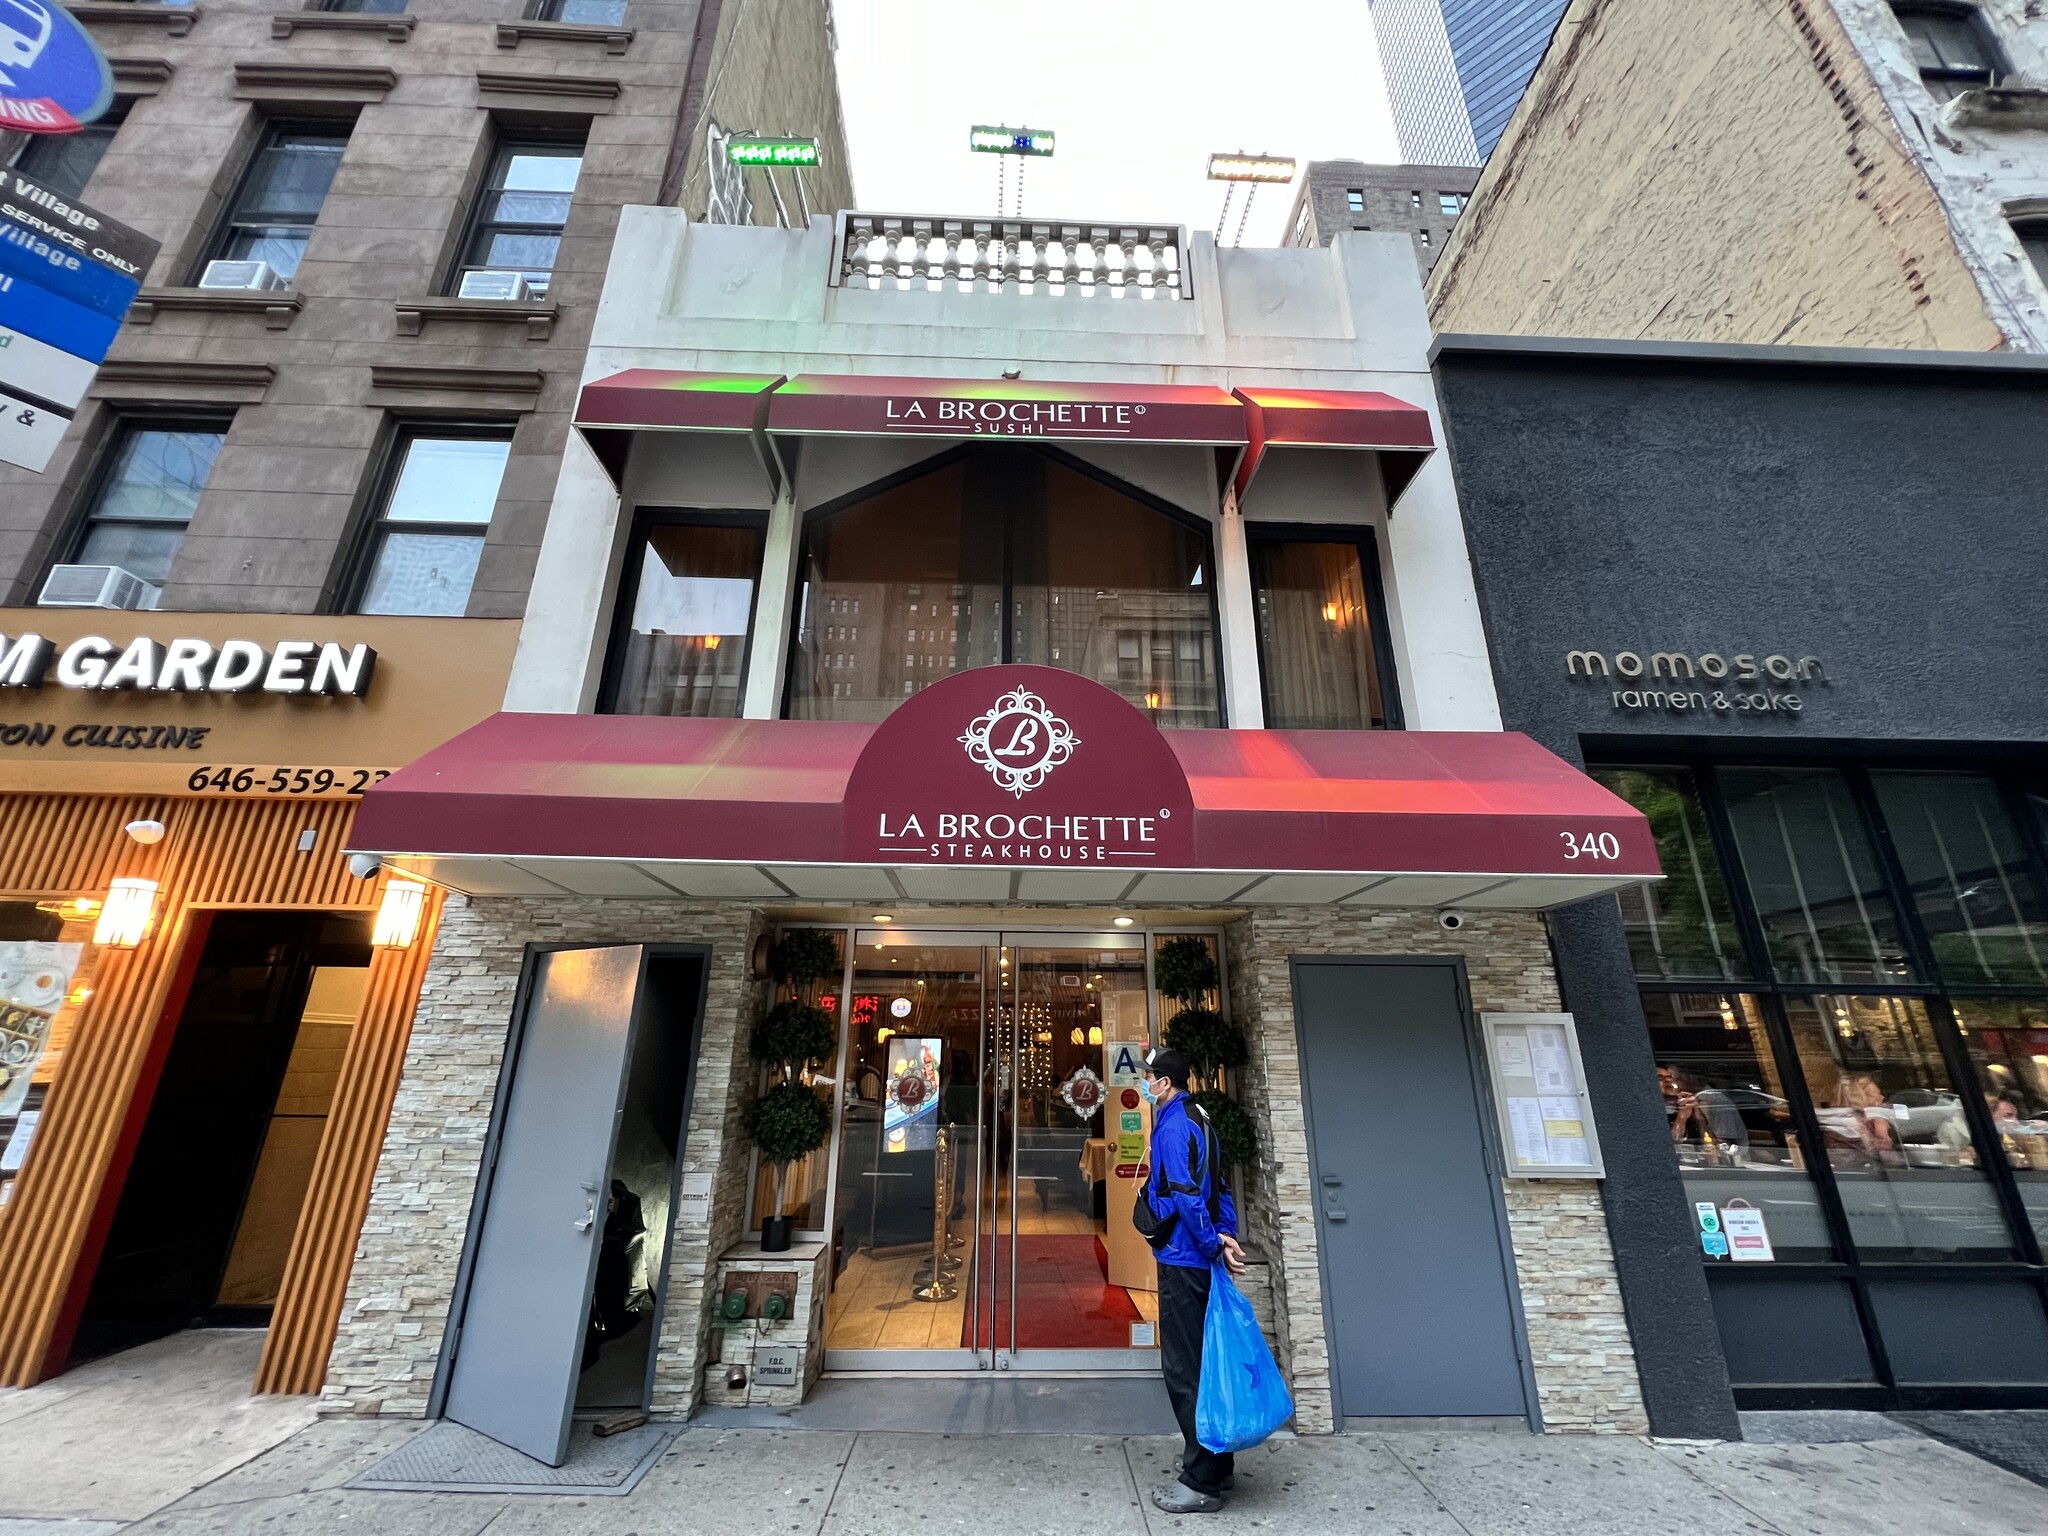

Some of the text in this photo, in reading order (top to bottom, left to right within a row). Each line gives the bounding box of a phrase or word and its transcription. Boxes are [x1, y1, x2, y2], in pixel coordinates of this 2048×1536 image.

[15, 178, 101, 232] Village
[0, 202, 142, 275] SERVICE ONLY
[887, 400, 1131, 424] LA BROCHETTE
[974, 422, 1044, 434] SUSHI
[56, 635, 372, 695] GARDEN
[1565, 650, 1832, 682] momosan
[1612, 688, 1804, 711] ramen & sake
[0, 722, 211, 750] ON CUISINE
[879, 813, 1156, 842] LA BROCHETTE
[930, 844, 1106, 860] STEAKHOUSE
[1559, 831, 1620, 860] 340
[1114, 1047, 1137, 1074] A
[760, 1367, 792, 1375] SPRINKLER
